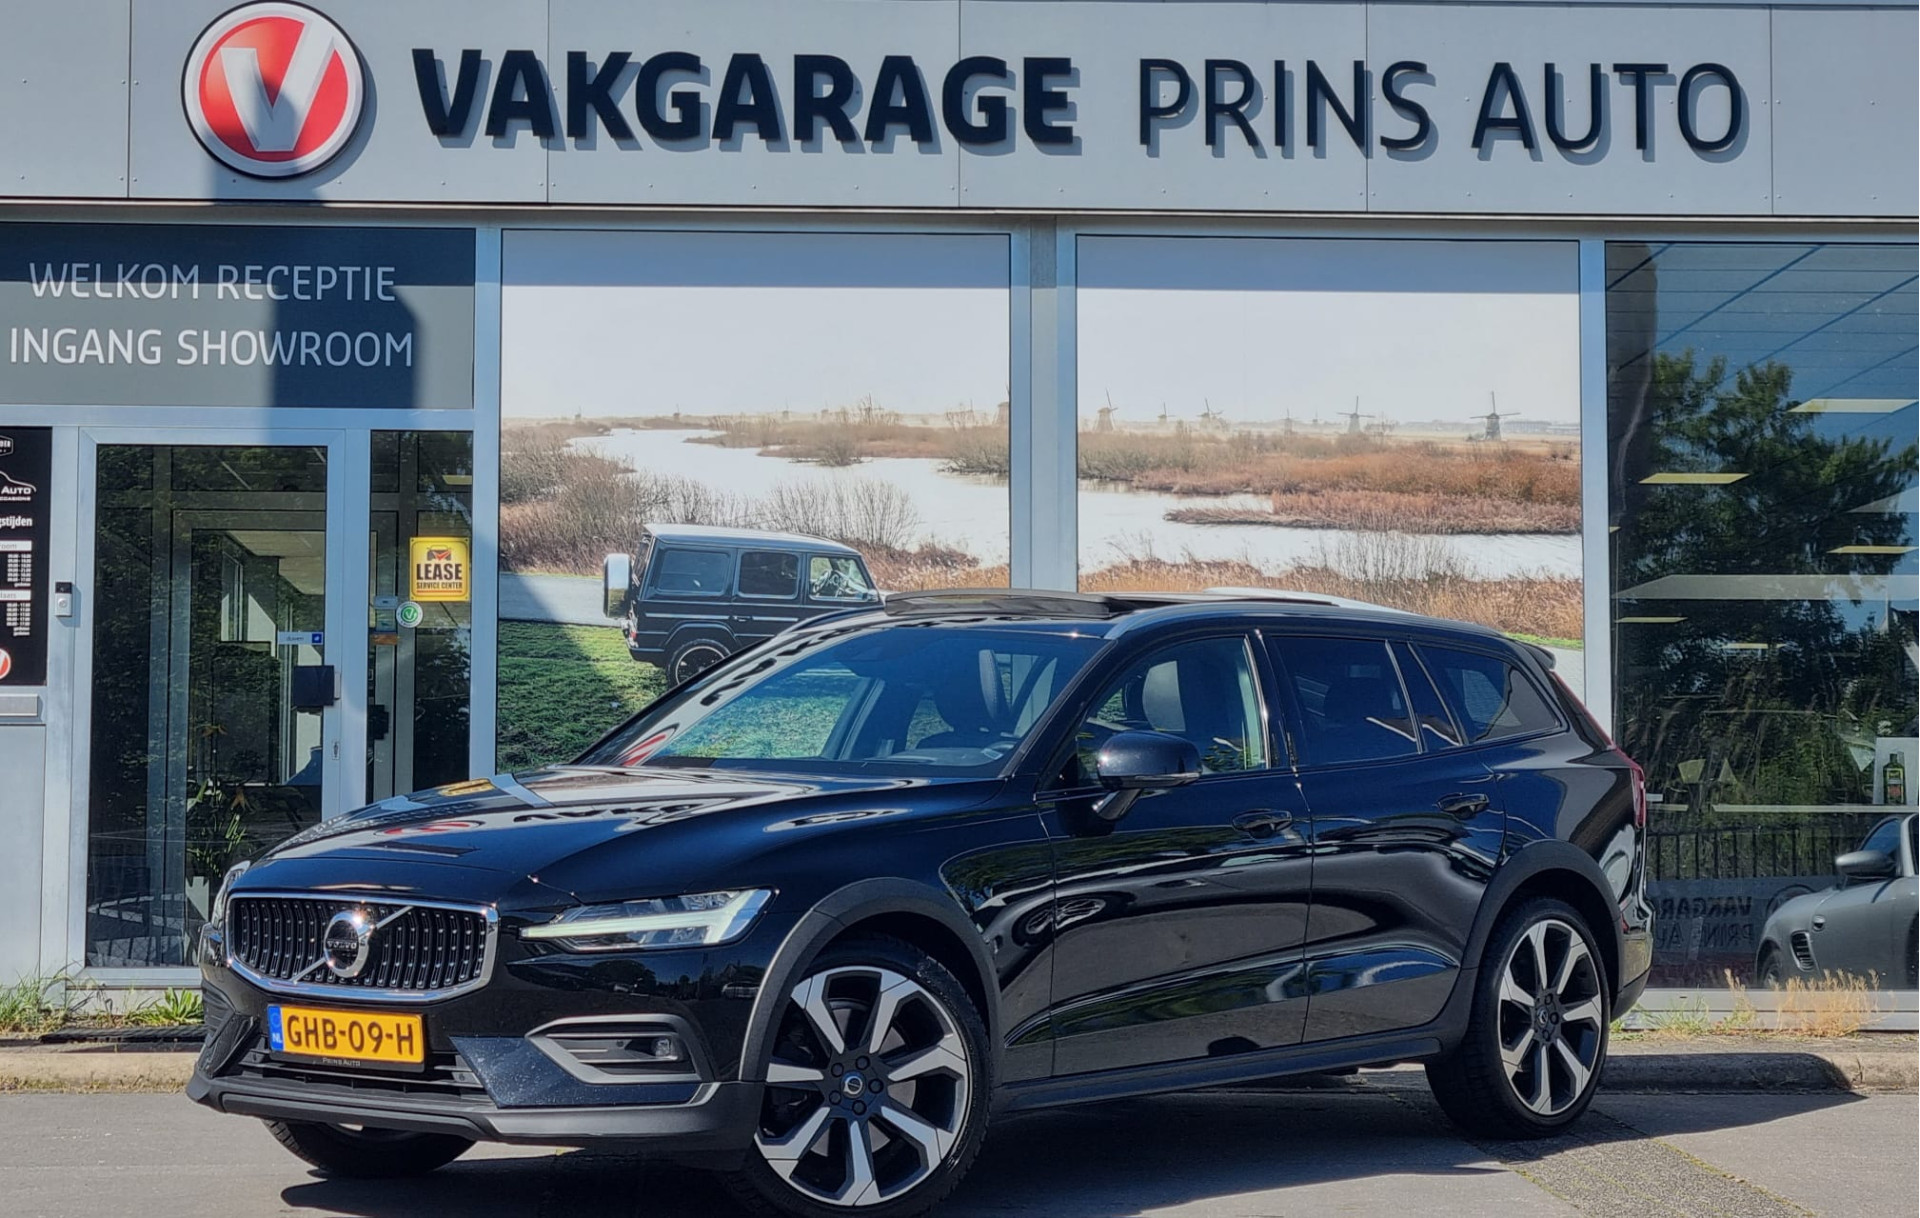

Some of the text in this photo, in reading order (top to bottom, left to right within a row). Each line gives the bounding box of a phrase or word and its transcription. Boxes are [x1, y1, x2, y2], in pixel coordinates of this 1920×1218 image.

[411, 48, 1743, 151] VAKGARAGE PRINS AUTO
[29, 262, 396, 301] WELKOM RECEPTIE
[10, 327, 412, 367] INGANG SHOWROOM
[1, 486, 31, 494] AUTO
[416, 563, 462, 581] LEASE
[416, 582, 463, 590] SERVICE CENTER
[272, 1014, 415, 1056] NL GHB-09-H
